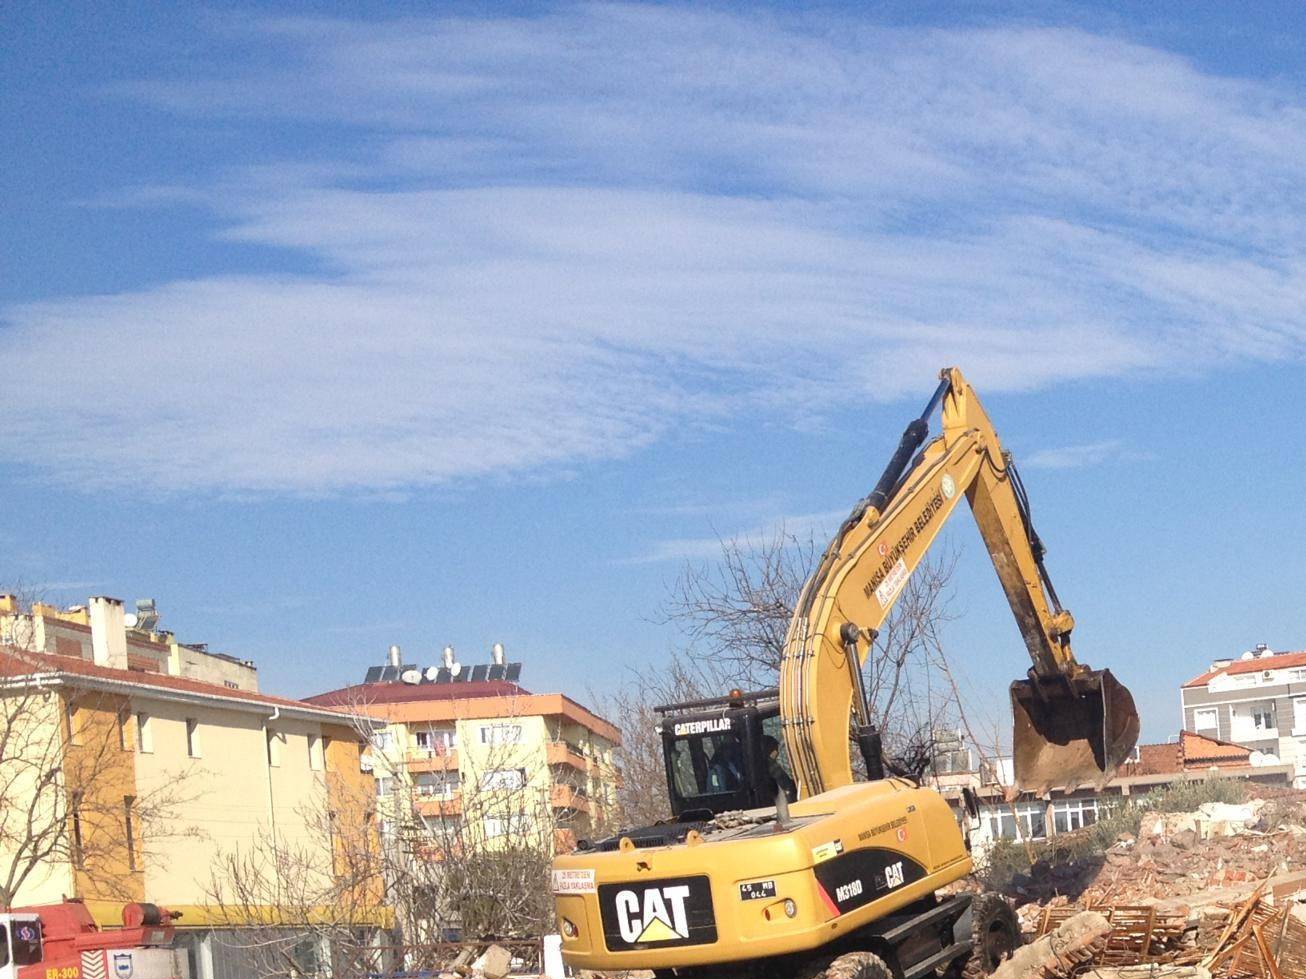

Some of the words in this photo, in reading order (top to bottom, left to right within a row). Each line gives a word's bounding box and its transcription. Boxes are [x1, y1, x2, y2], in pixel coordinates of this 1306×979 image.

[674, 718, 731, 736] CATERPILLAR
[885, 861, 905, 889] CAT
[835, 879, 863, 903] M318D
[615, 885, 690, 943] CAT
